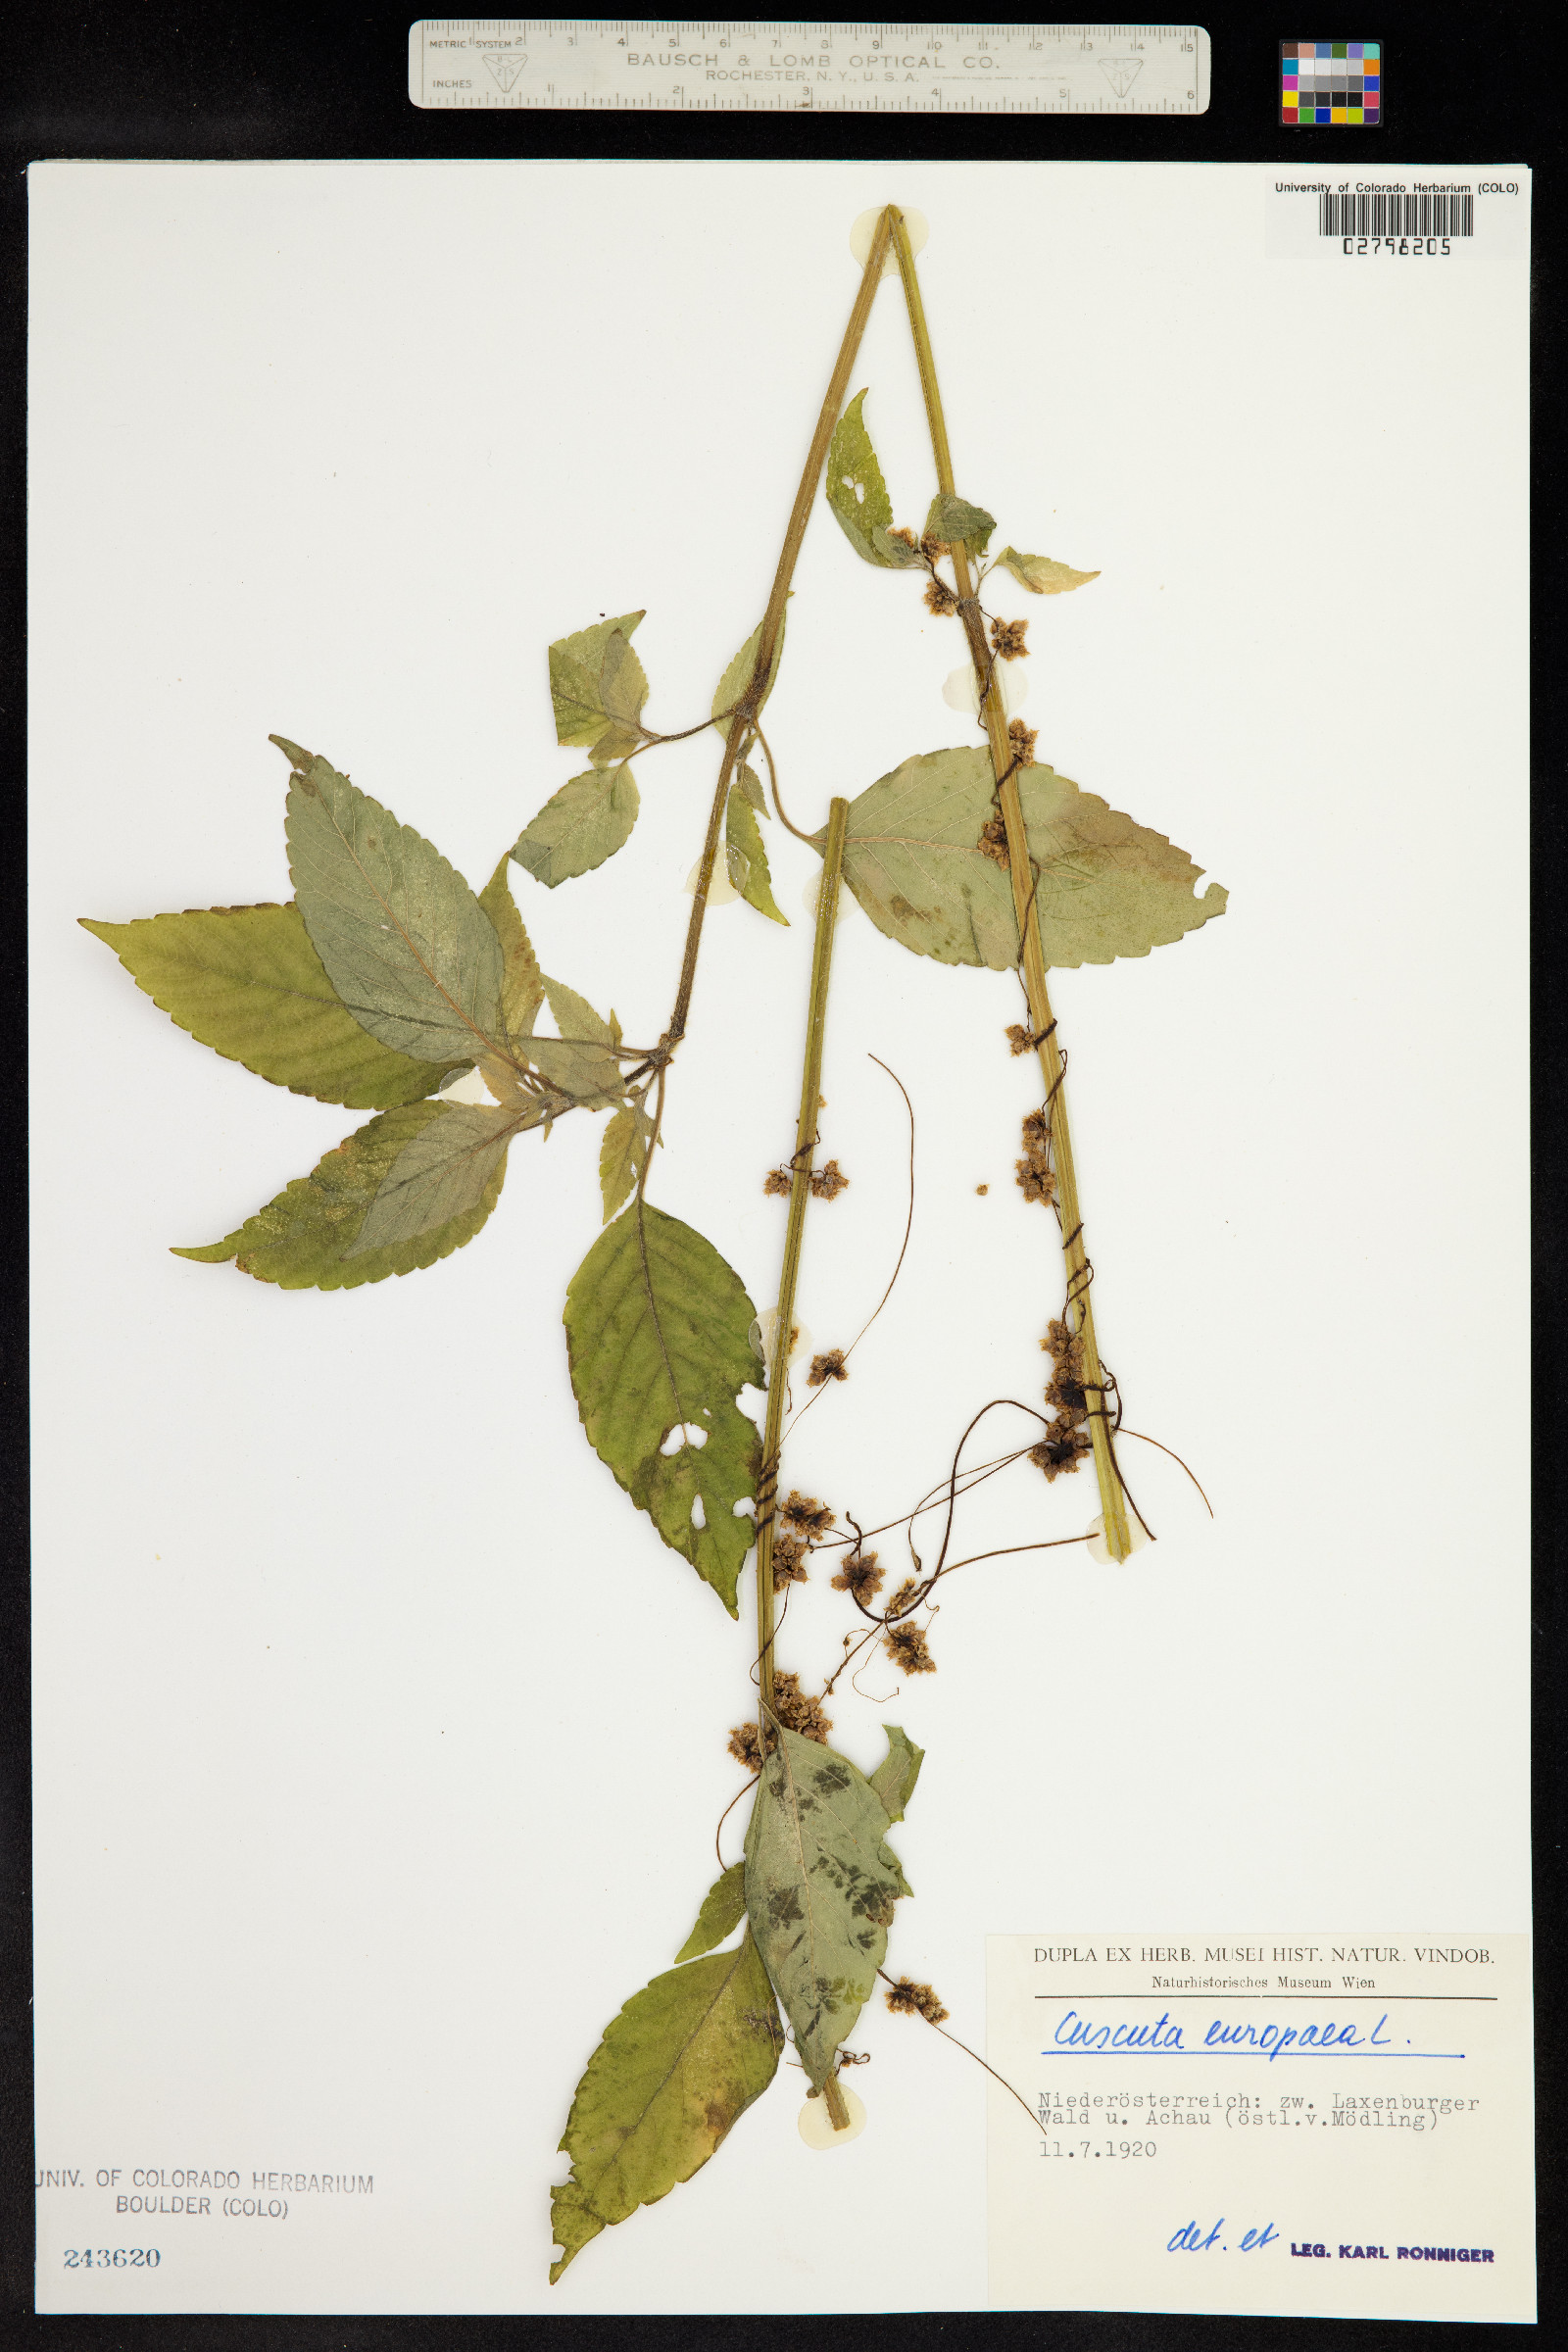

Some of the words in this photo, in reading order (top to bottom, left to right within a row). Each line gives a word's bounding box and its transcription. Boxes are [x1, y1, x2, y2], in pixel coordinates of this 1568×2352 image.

[514, 37, 523, 46] 2
[567, 37, 574, 46] 3
[617, 38, 626, 47] 4
[719, 39, 727, 48] 6
[872, 40, 879, 49] 9
[1029, 42, 1043, 51] 12
[1181, 43, 1194, 52] 15
[627, 53, 718, 67] BAUSCH
[738, 55, 751, 67] &
[770, 54, 831, 68] LOMB
[849, 56, 946, 69] OPTICAL
[962, 56, 1000, 69] CO.
[432, 79, 472, 88] INCHES
[803, 86, 809, 95] 3
[931, 87, 939, 96] 4
[1187, 90, 1195, 100] 6
[1275, 182, 1332, 194] University
[1338, 182, 1348, 193] of
[1355, 182, 1406, 193] Colorado
[1413, 182, 1471, 193] Herbarium
[1478, 182, 1519, 195] (COLO)
[1033, 1946, 1099, 1964] DUPLA
[1105, 1946, 1132, 1964] EX
[1140, 1946, 1197, 1964] HERB.
[1203, 1946, 1266, 1964] MUSEI
[1272, 1946, 1323, 1964] HIST.
[1331, 1946, 1406, 1964] NATUR.
[1413, 1946, 1496, 1965] VINDOB.
[1151, 1975, 1268, 1989] Naturhistorisches
[1277, 1976, 1332, 1989] Museum
[1342, 1976, 1377, 1989] Wien
[1053, 2010, 1185, 2050] Cuscuta
[1202, 2022, 1365, 2062] europaea
[1037, 2092, 1262, 2112] Niederösterreich:
[1279, 2094, 1316, 2112] zw.
[1331, 2092, 1481, 2114] Laxenburger
[1037, 2108, 1091, 2127] Wald
[1104, 2111, 1130, 2127] u.
[1145, 2110, 1212, 2127] Achau
[1038, 2140, 1157, 2160] 11.7.1920
[95, 2169, 122, 2186] OF
[132, 2169, 241, 2189] COLORADO
[253, 2172, 374, 2194] HERBARIUM
[116, 2195, 212, 2216] BOULDER
[222, 2197, 289, 2220] (COLO)
[1237, 2222, 1281, 2251] et
[63, 2247, 162, 2269] 243620
[1291, 2243, 1332, 2259] LEG.
[1338, 2243, 1390, 2261] KARL
[1396, 2245, 1495, 2264] RONNIGER
